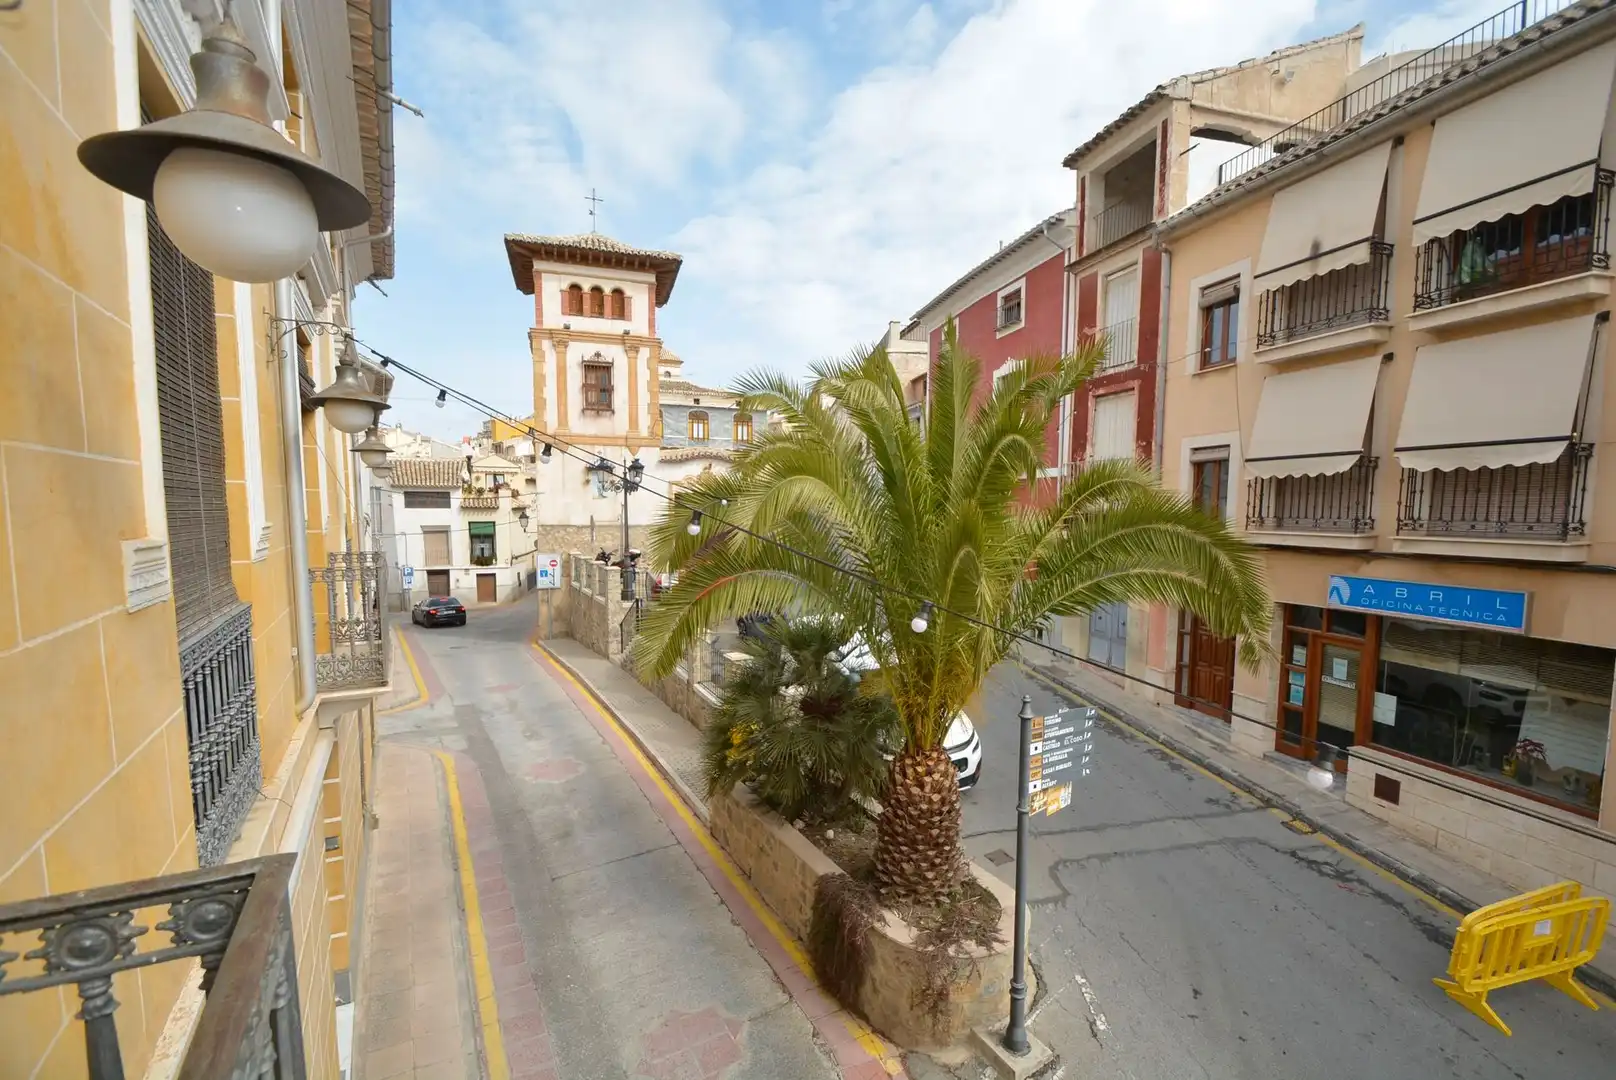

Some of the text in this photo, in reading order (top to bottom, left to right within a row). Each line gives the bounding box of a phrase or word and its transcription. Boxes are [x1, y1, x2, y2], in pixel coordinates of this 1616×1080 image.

[404, 567, 412, 575] P
[1360, 597, 1507, 621] OFICINA TECNICA
[1363, 584, 1508, 610] ABRIL
